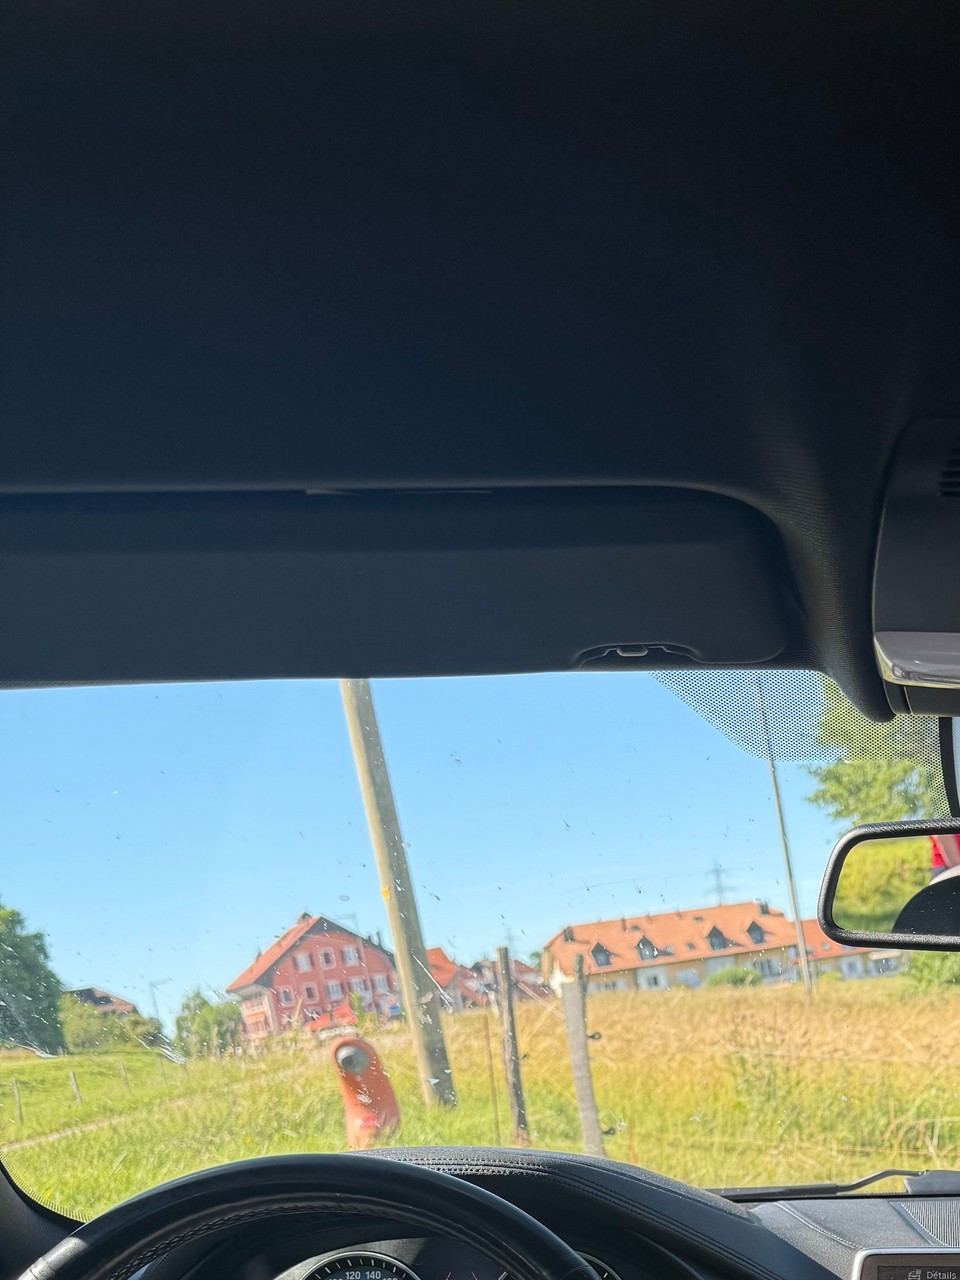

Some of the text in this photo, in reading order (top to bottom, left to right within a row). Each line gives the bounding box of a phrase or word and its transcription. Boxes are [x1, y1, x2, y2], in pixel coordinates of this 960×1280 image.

[345, 1271, 361, 1280] 120
[365, 1271, 381, 1280] 140
[926, 1271, 957, 1280] Détails
